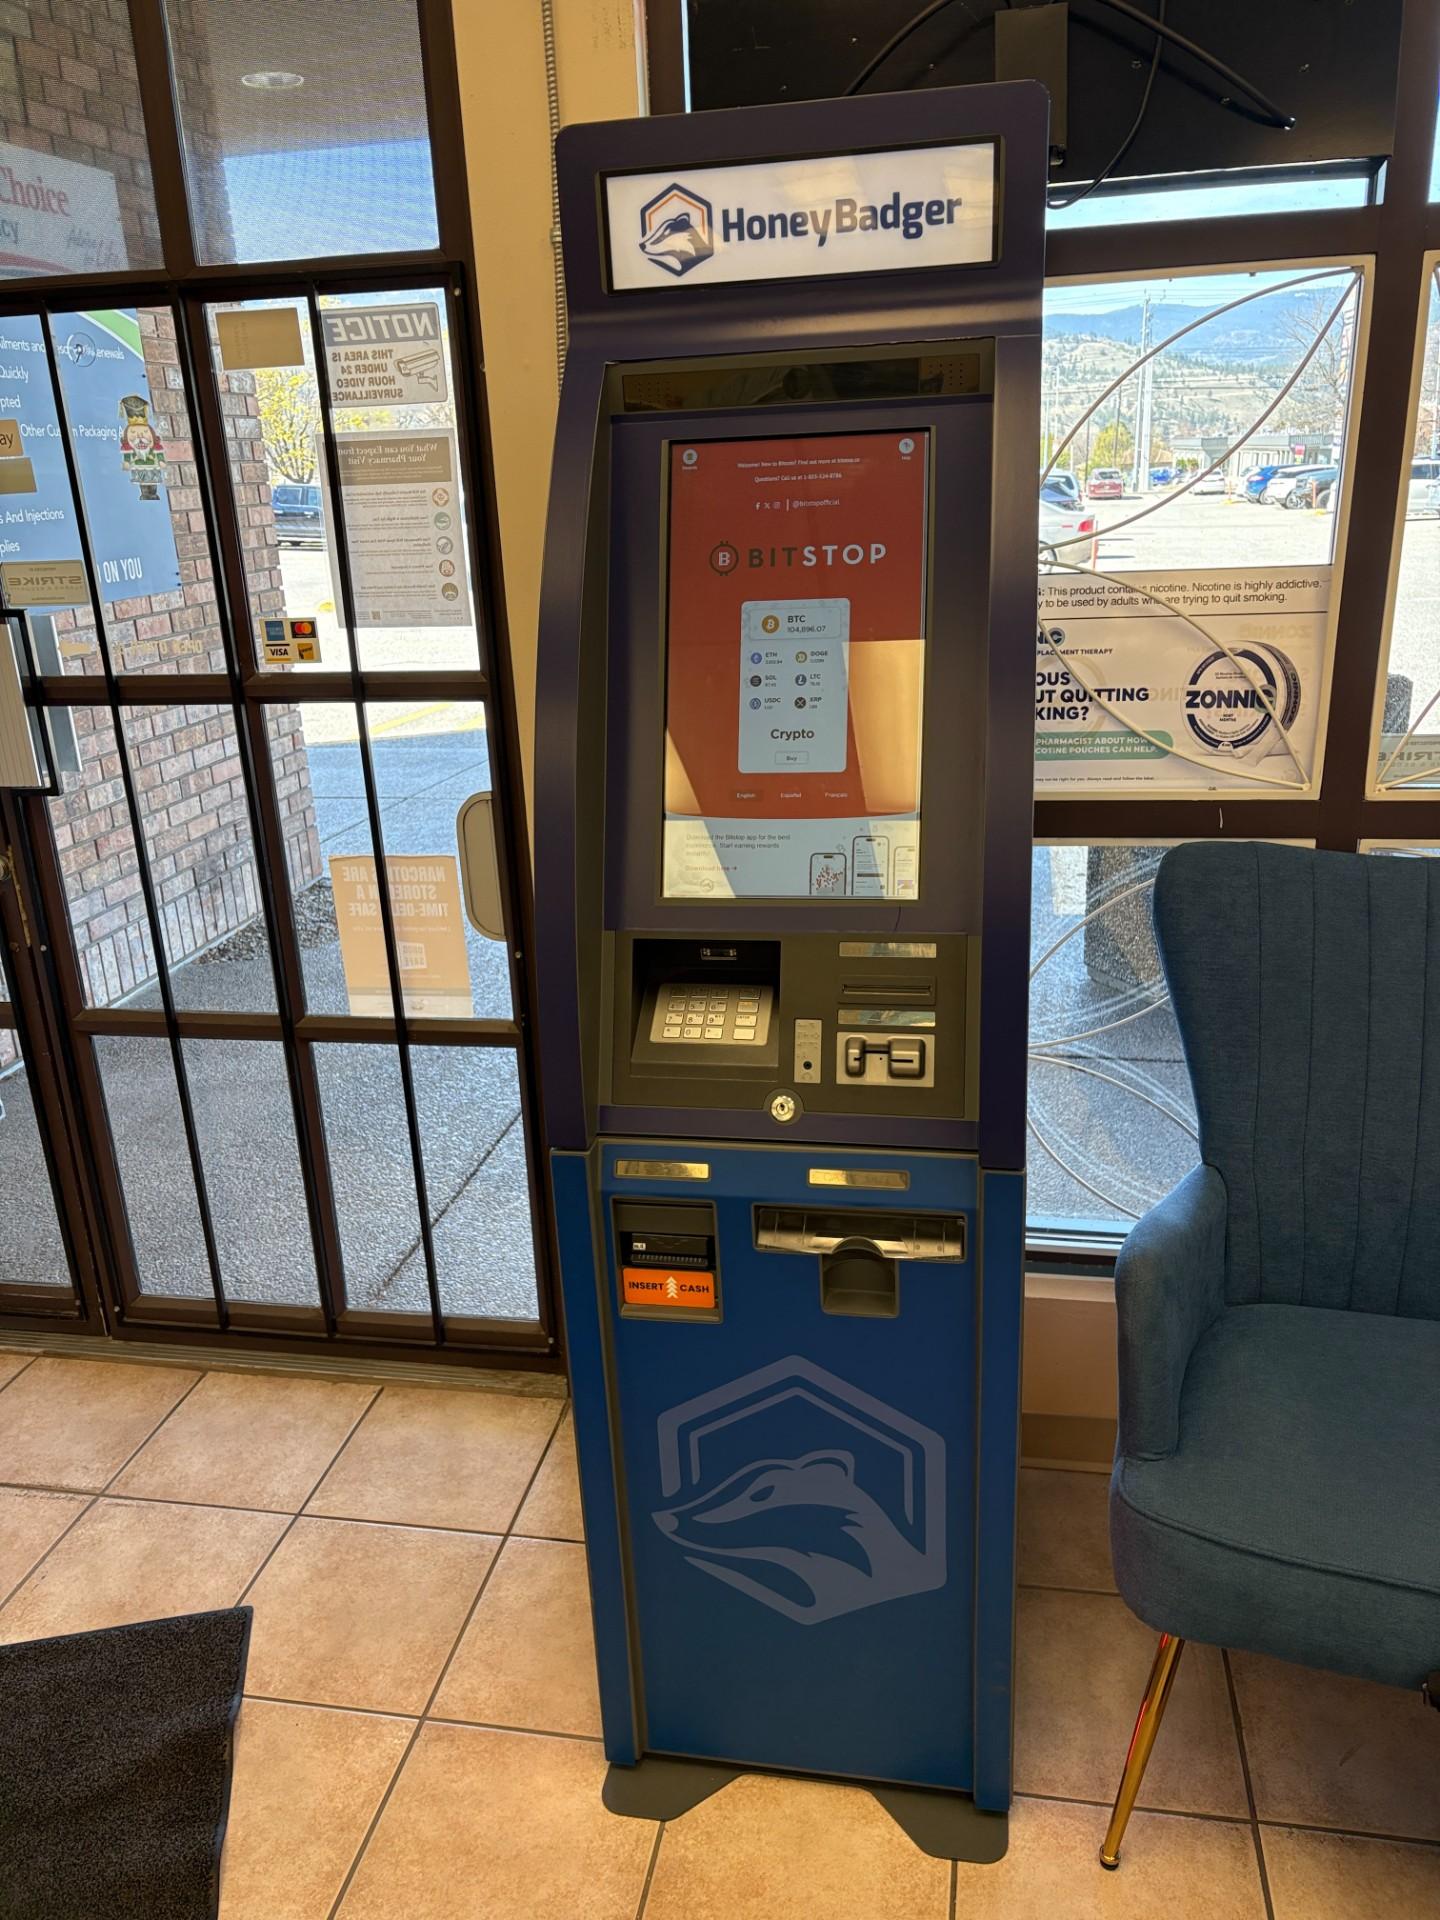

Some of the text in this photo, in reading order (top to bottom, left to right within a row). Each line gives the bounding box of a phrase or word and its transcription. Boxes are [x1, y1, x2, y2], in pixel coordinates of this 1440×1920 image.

[721, 191, 962, 247] HoneyBadger
[20, 423, 45, 437] Other
[79, 424, 118, 440] Packaging
[6, 509, 24, 523] And
[25, 507, 65, 525] Injections
[749, 543, 887, 568] BITSTOP
[103, 561, 120, 584] ON
[120, 557, 143, 580] YOU
[1047, 586, 1068, 596] This
[1070, 585, 1106, 597] product
[1149, 583, 1190, 593] nicotine.
[1192, 581, 1232, 592] Nicotine
[1233, 581, 1242, 591] is
[1244, 580, 1273, 593] highly
[1275, 579, 1322, 590] addictive.
[1045, 599, 1054, 608] to
[1056, 598, 1069, 607] be
[1071, 597, 1095, 607] used
[1096, 597, 1109, 608] by
[1110, 596, 1139, 605] adults
[1182, 594, 1209, 605] trying
[1211, 594, 1221, 603] to
[1222, 593, 1241, 604] quit
[1243, 592, 1288, 604] smoking.
[787, 615, 806, 623] BTC
[269, 648, 288, 656] VISA
[770, 728, 815, 741] Crypto
[1035, 737, 1092, 746] PHARMACIST
[1094, 736, 1126, 745] ABOUT
[1069, 746, 1110, 754] POUCHES
[628, 1281, 710, 1293] INSERT CASH
